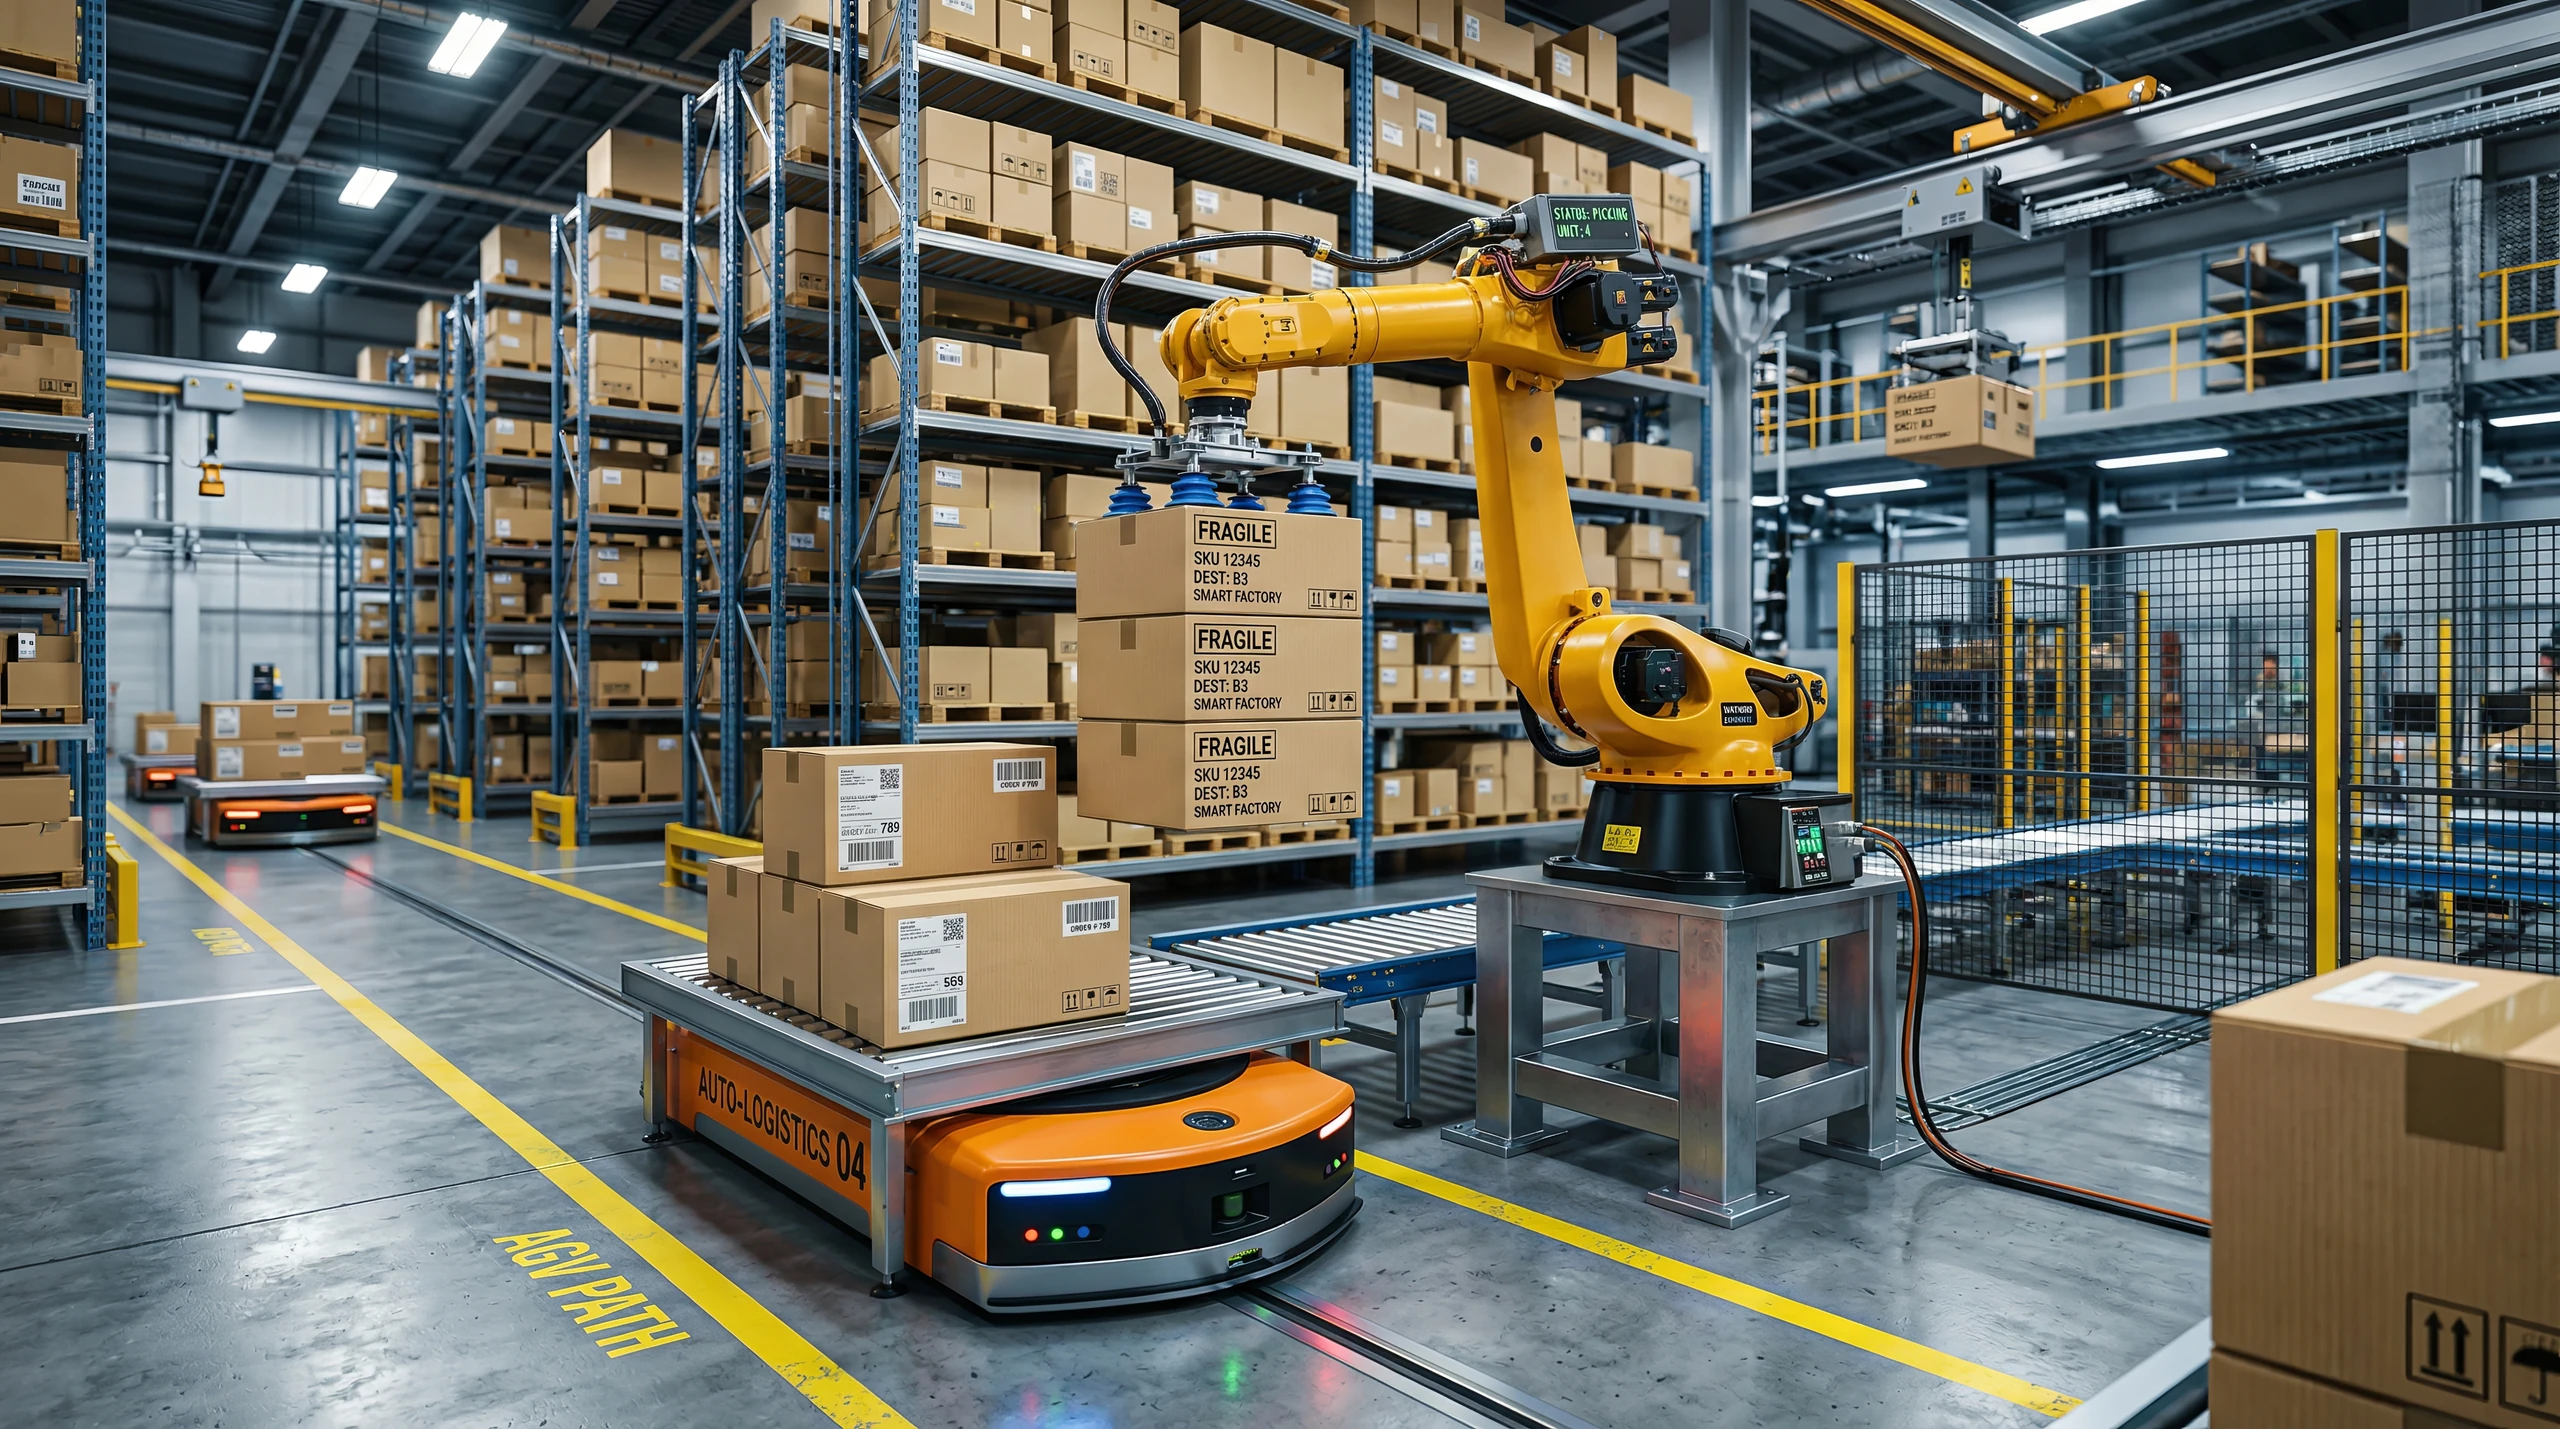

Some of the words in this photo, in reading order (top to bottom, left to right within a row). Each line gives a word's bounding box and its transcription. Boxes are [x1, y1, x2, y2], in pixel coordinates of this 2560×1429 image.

[1199, 520, 1272, 543] FRAGILE
[1194, 551, 1219, 566] SKU
[1223, 553, 1261, 567] 12345
[1194, 570, 1230, 585] DEST:
[1233, 572, 1248, 585] B3
[1193, 589, 1232, 602] SMART
[1235, 590, 1282, 604] FACTORY
[1199, 629, 1272, 650] FRAGILE
[1194, 660, 1220, 674] SKU
[1223, 661, 1261, 674] 12345
[1194, 679, 1229, 693] DEST:
[1233, 679, 1248, 693] B3
[1194, 698, 1233, 710] SMART
[1235, 697, 1282, 710] FACTORY
[1199, 736, 1272, 757] FRAGILE
[1194, 768, 1220, 782] SKU
[1223, 766, 1261, 781] 12345
[1194, 786, 1230, 801] DEST:
[1233, 784, 1248, 799] B3
[1194, 804, 1233, 818] SMART
[1235, 801, 1282, 816] FACTORY
[880, 821, 900, 834] 789
[698, 1066, 830, 1167] AUTO-LOGISTICS
[836, 1131, 866, 1191] 04
[493, 1228, 612, 1280] AGV
[547, 1275, 691, 1359] PATH
